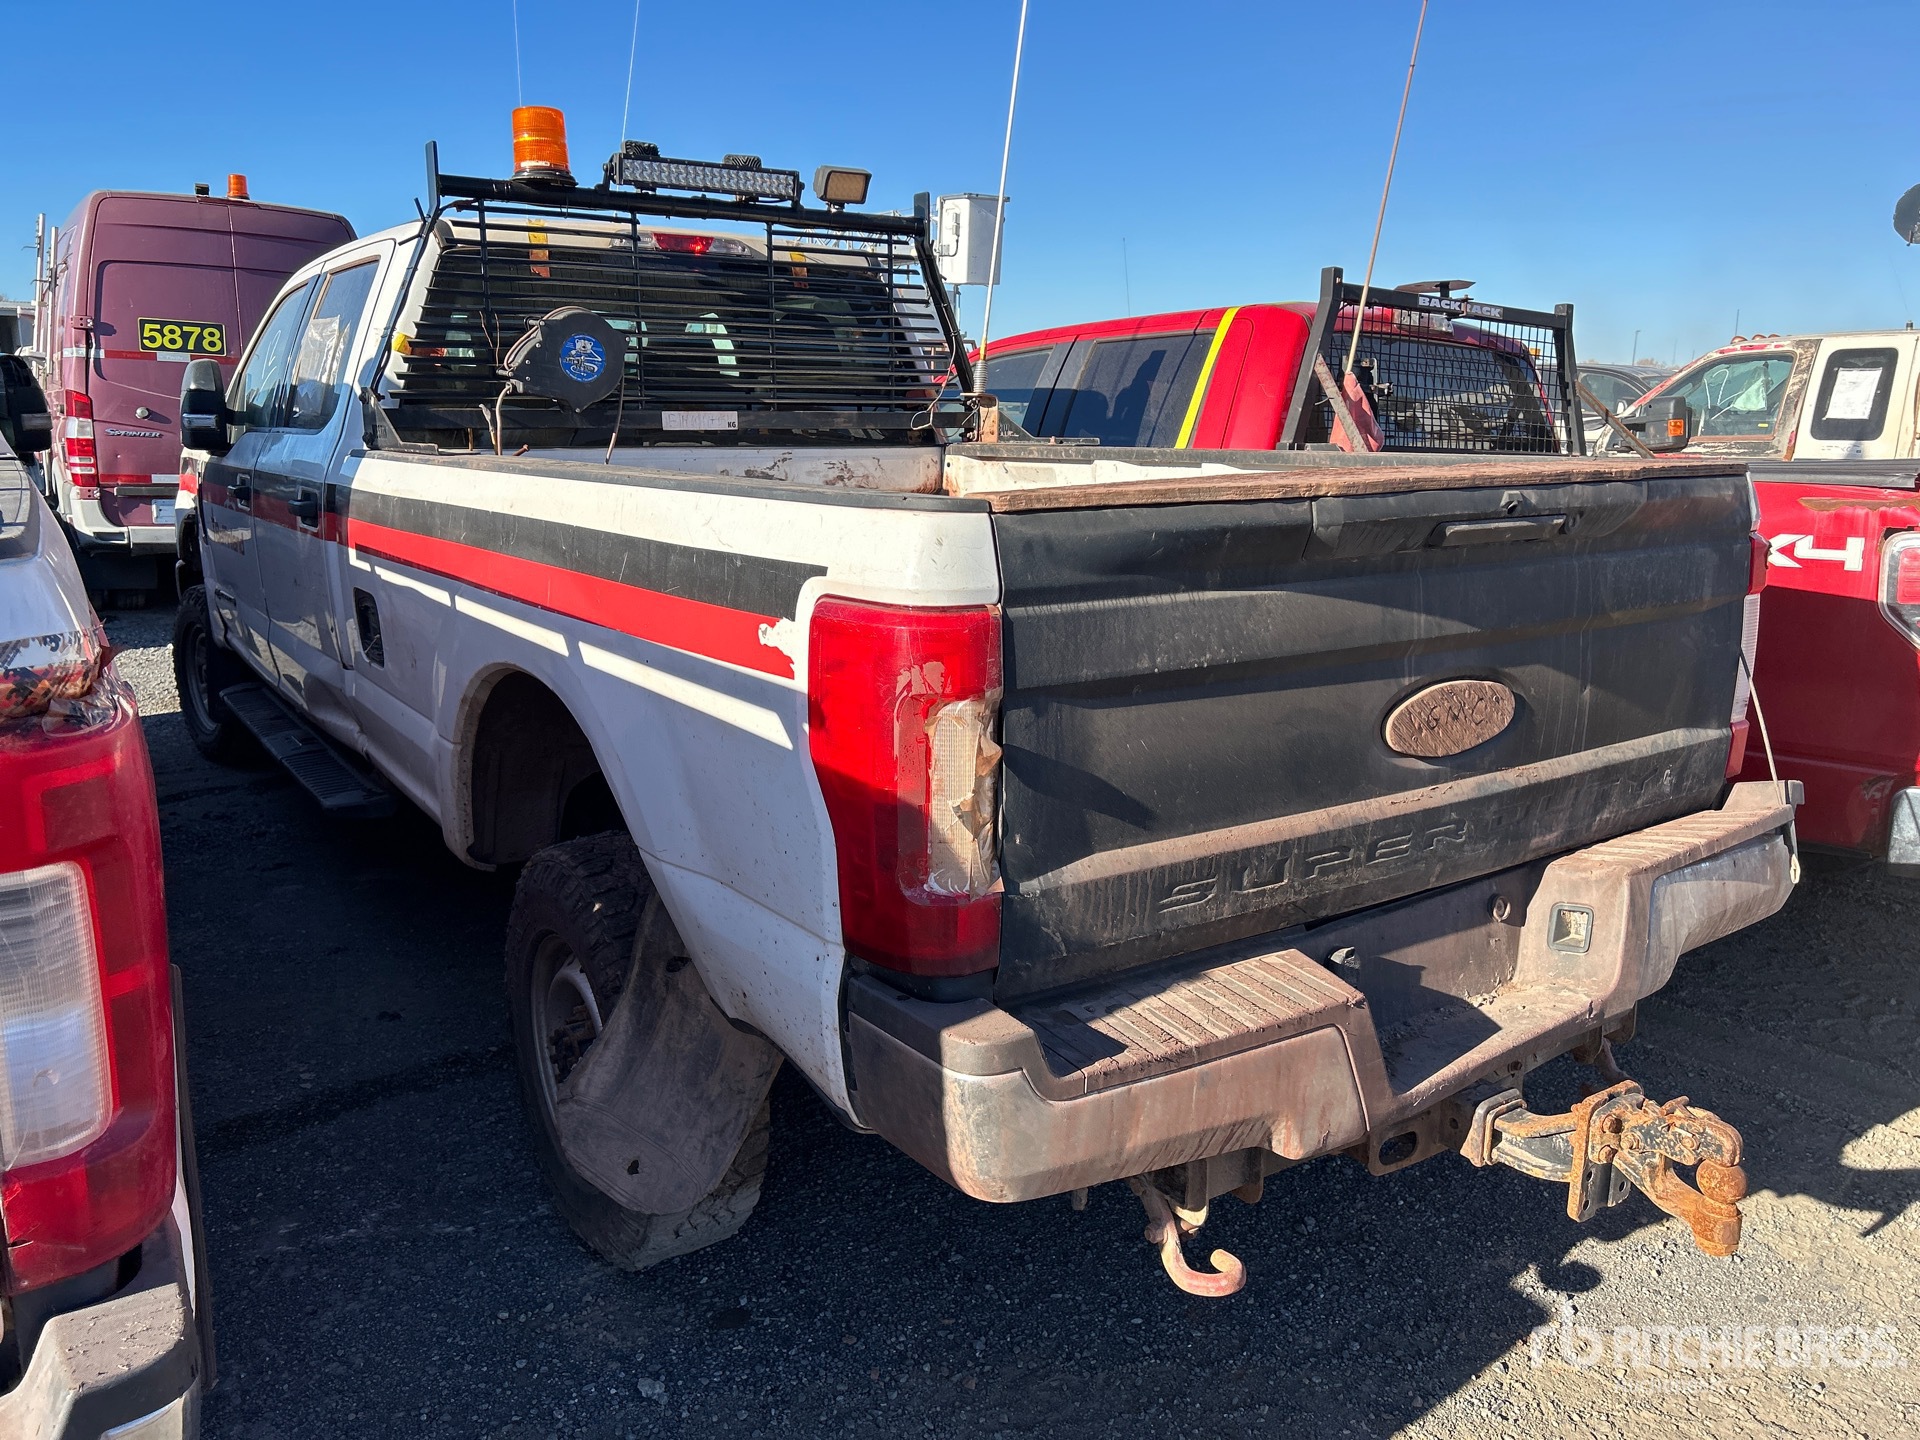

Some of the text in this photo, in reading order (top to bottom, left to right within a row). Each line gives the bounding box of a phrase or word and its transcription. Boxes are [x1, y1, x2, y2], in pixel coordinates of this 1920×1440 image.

[142, 322, 222, 352] 5878
[727, 421, 737, 429] KG
[1157, 816, 1470, 915] SUPER
